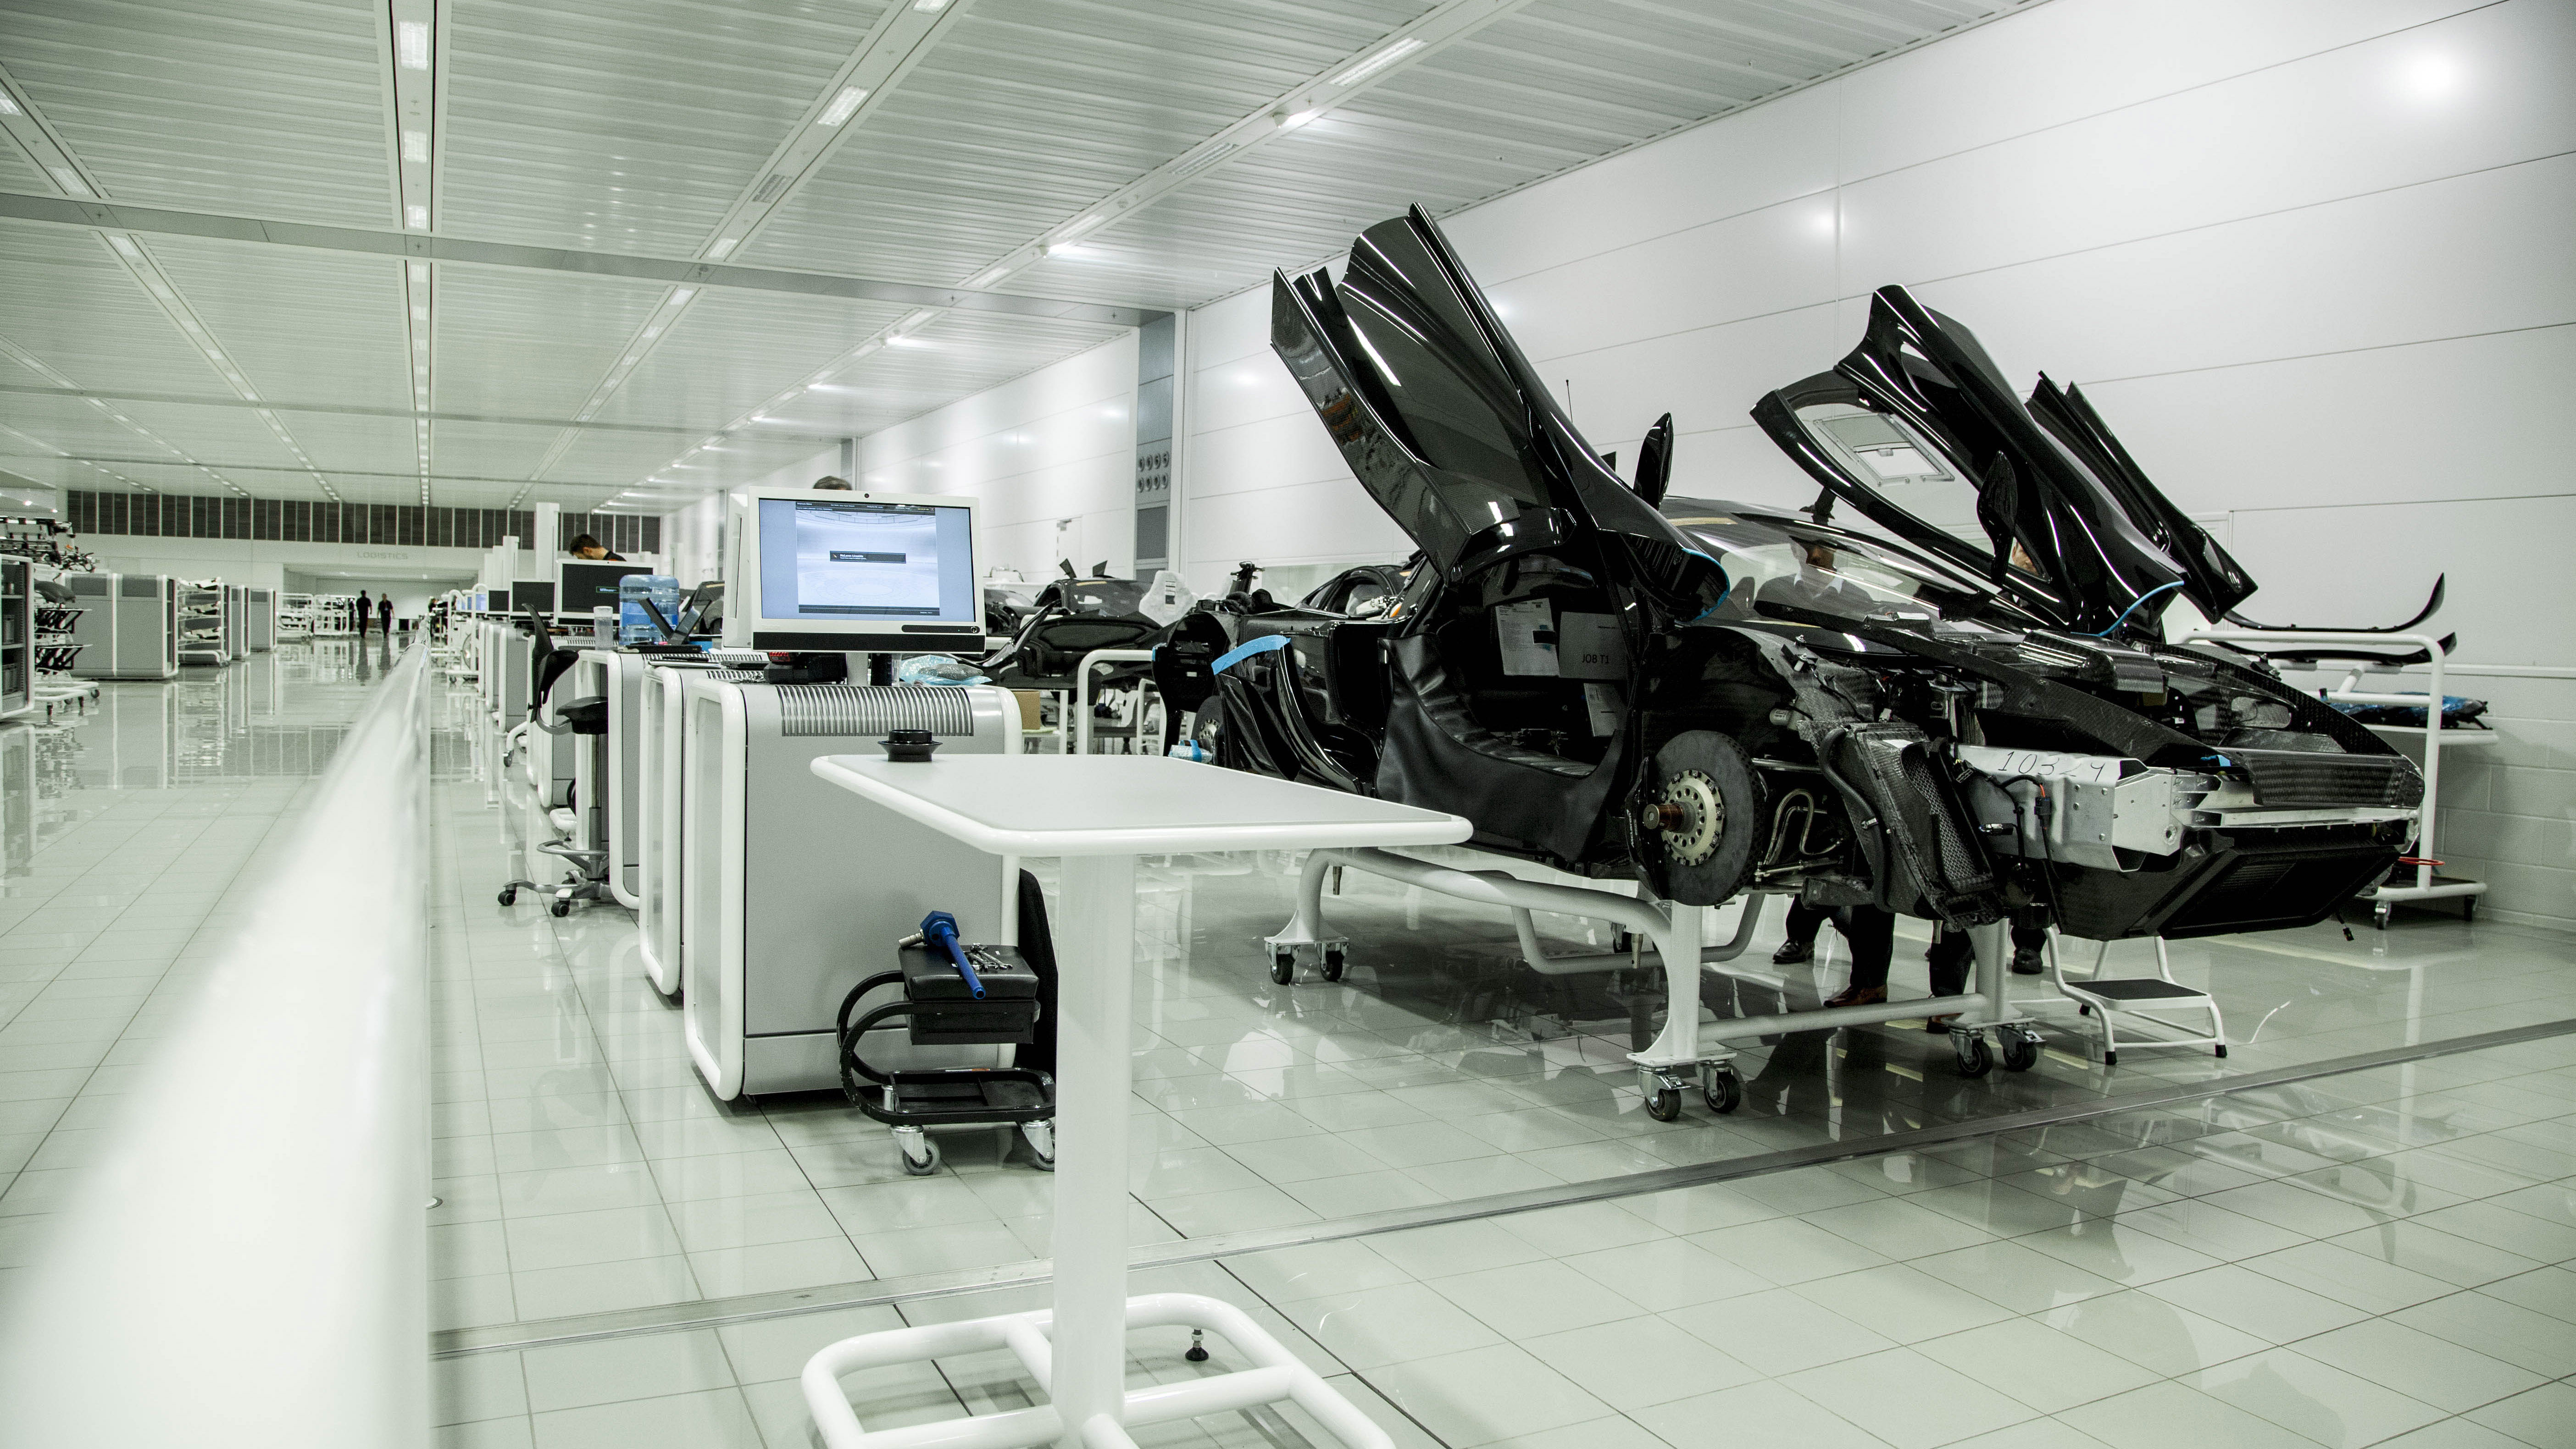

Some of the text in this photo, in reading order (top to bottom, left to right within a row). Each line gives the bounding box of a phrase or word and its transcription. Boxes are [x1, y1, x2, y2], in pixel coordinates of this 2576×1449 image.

[356, 551, 408, 560] LOGISTICS
[1582, 654, 1609, 664] JOB T1
